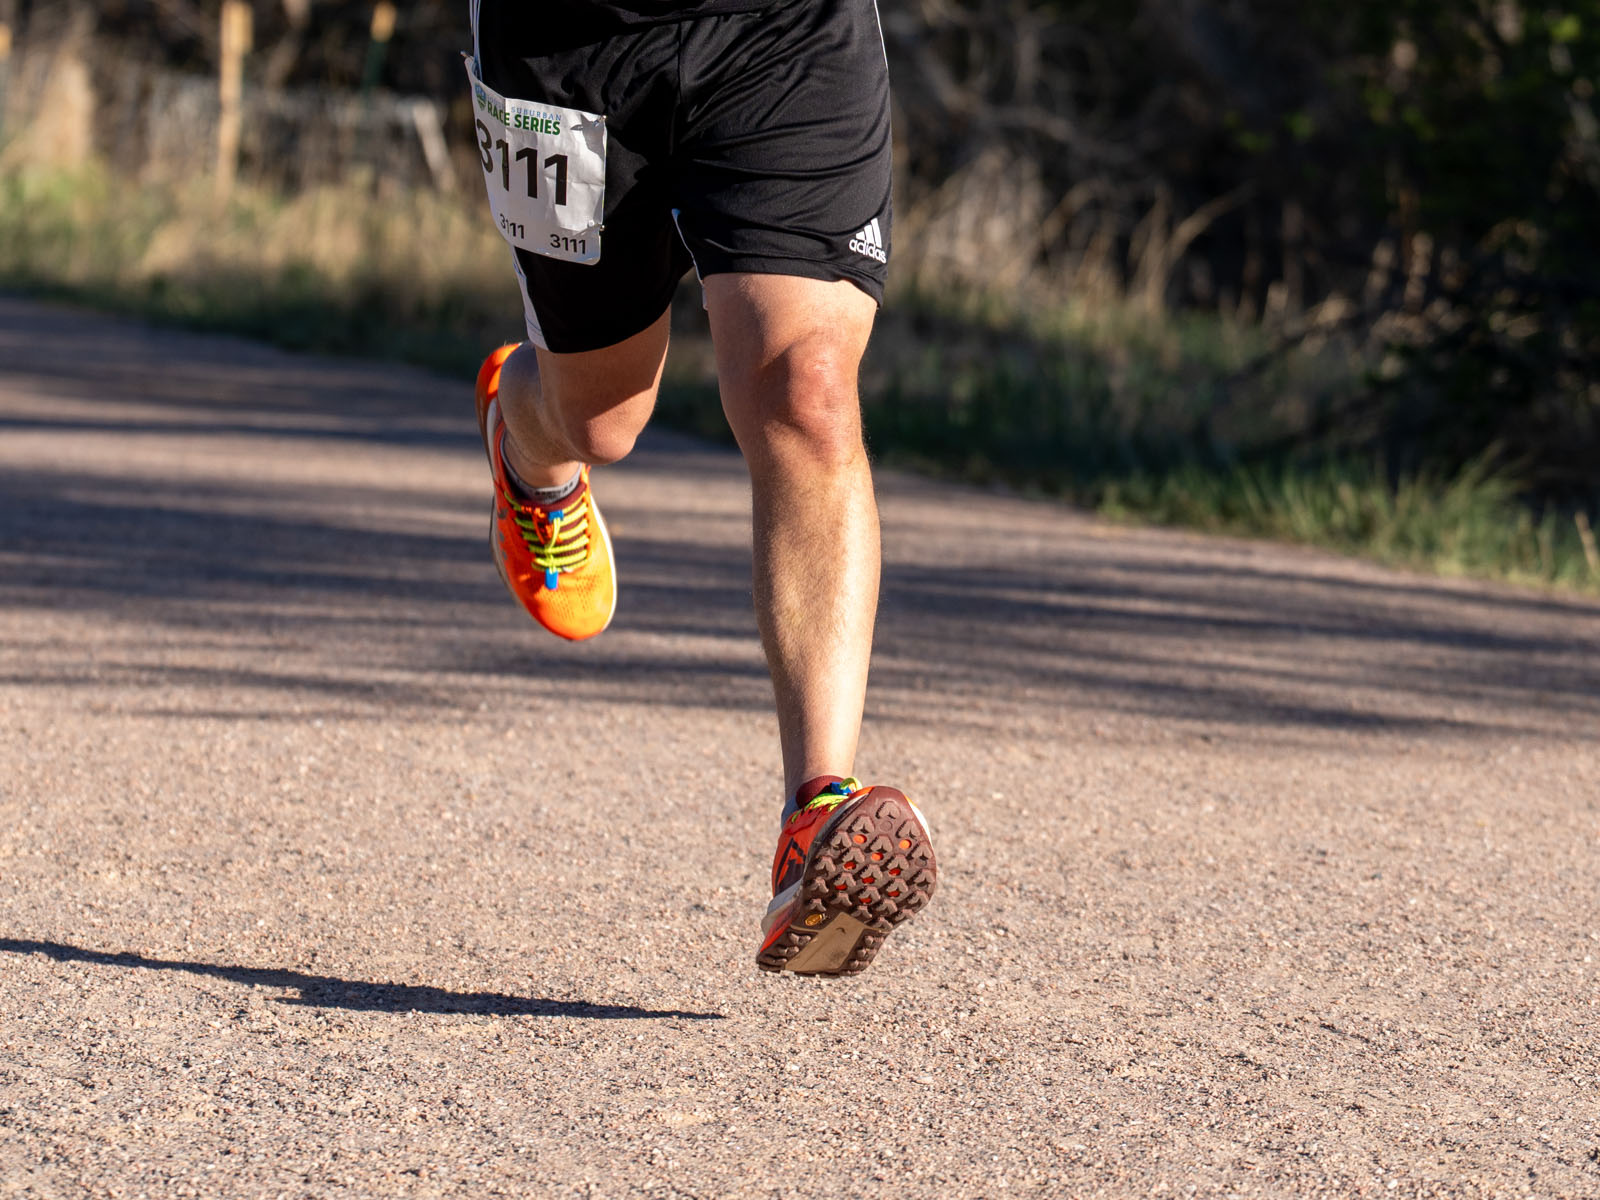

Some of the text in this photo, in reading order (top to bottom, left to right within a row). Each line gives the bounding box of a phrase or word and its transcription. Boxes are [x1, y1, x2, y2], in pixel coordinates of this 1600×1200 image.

[488, 101, 561, 136] RACE SERIES
[511, 106, 562, 121] SUBURBAN
[476, 118, 568, 206] 3111
[500, 213, 525, 240] 3111
[549, 233, 587, 255] 3111
[848, 238, 887, 264] adidas
